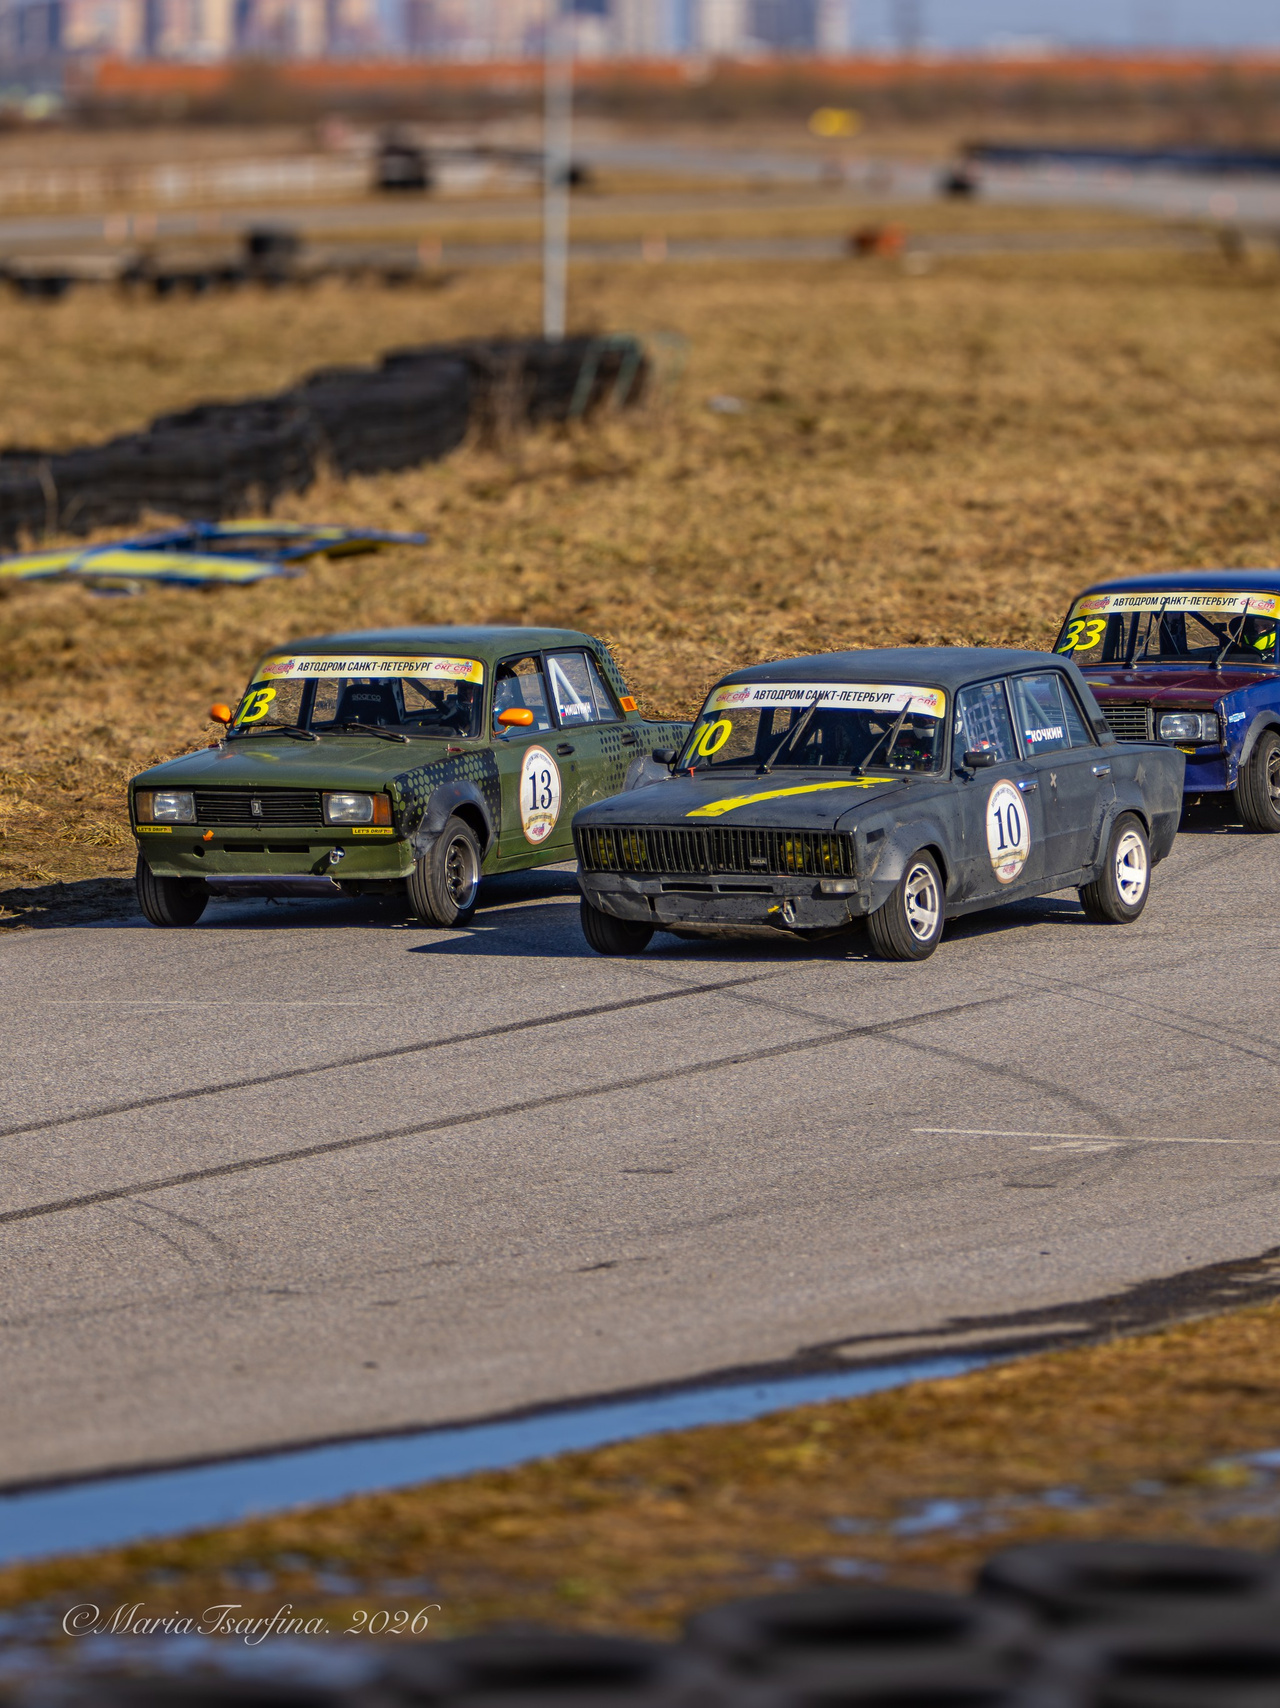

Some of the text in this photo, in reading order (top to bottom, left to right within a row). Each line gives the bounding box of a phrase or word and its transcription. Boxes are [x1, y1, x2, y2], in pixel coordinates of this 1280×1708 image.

[1113, 596, 1239, 607] АВТОДРОМ САНКТ-ПЕТЕРБУРГ
[1056, 619, 1107, 654] 33
[297, 661, 433, 672] АВТОДРОМ САНКТ-ПЕТЕРБУРГ
[234, 687, 277, 727] 13
[753, 689, 805, 700] АВТОДРОМ
[805, 690, 895, 703] САНКТ-ПЕТЕРБУРГ
[686, 719, 733, 760] 10
[1031, 726, 1064, 743] КОЧКИН
[528, 769, 553, 811] 13
[993, 802, 1022, 851] 10
